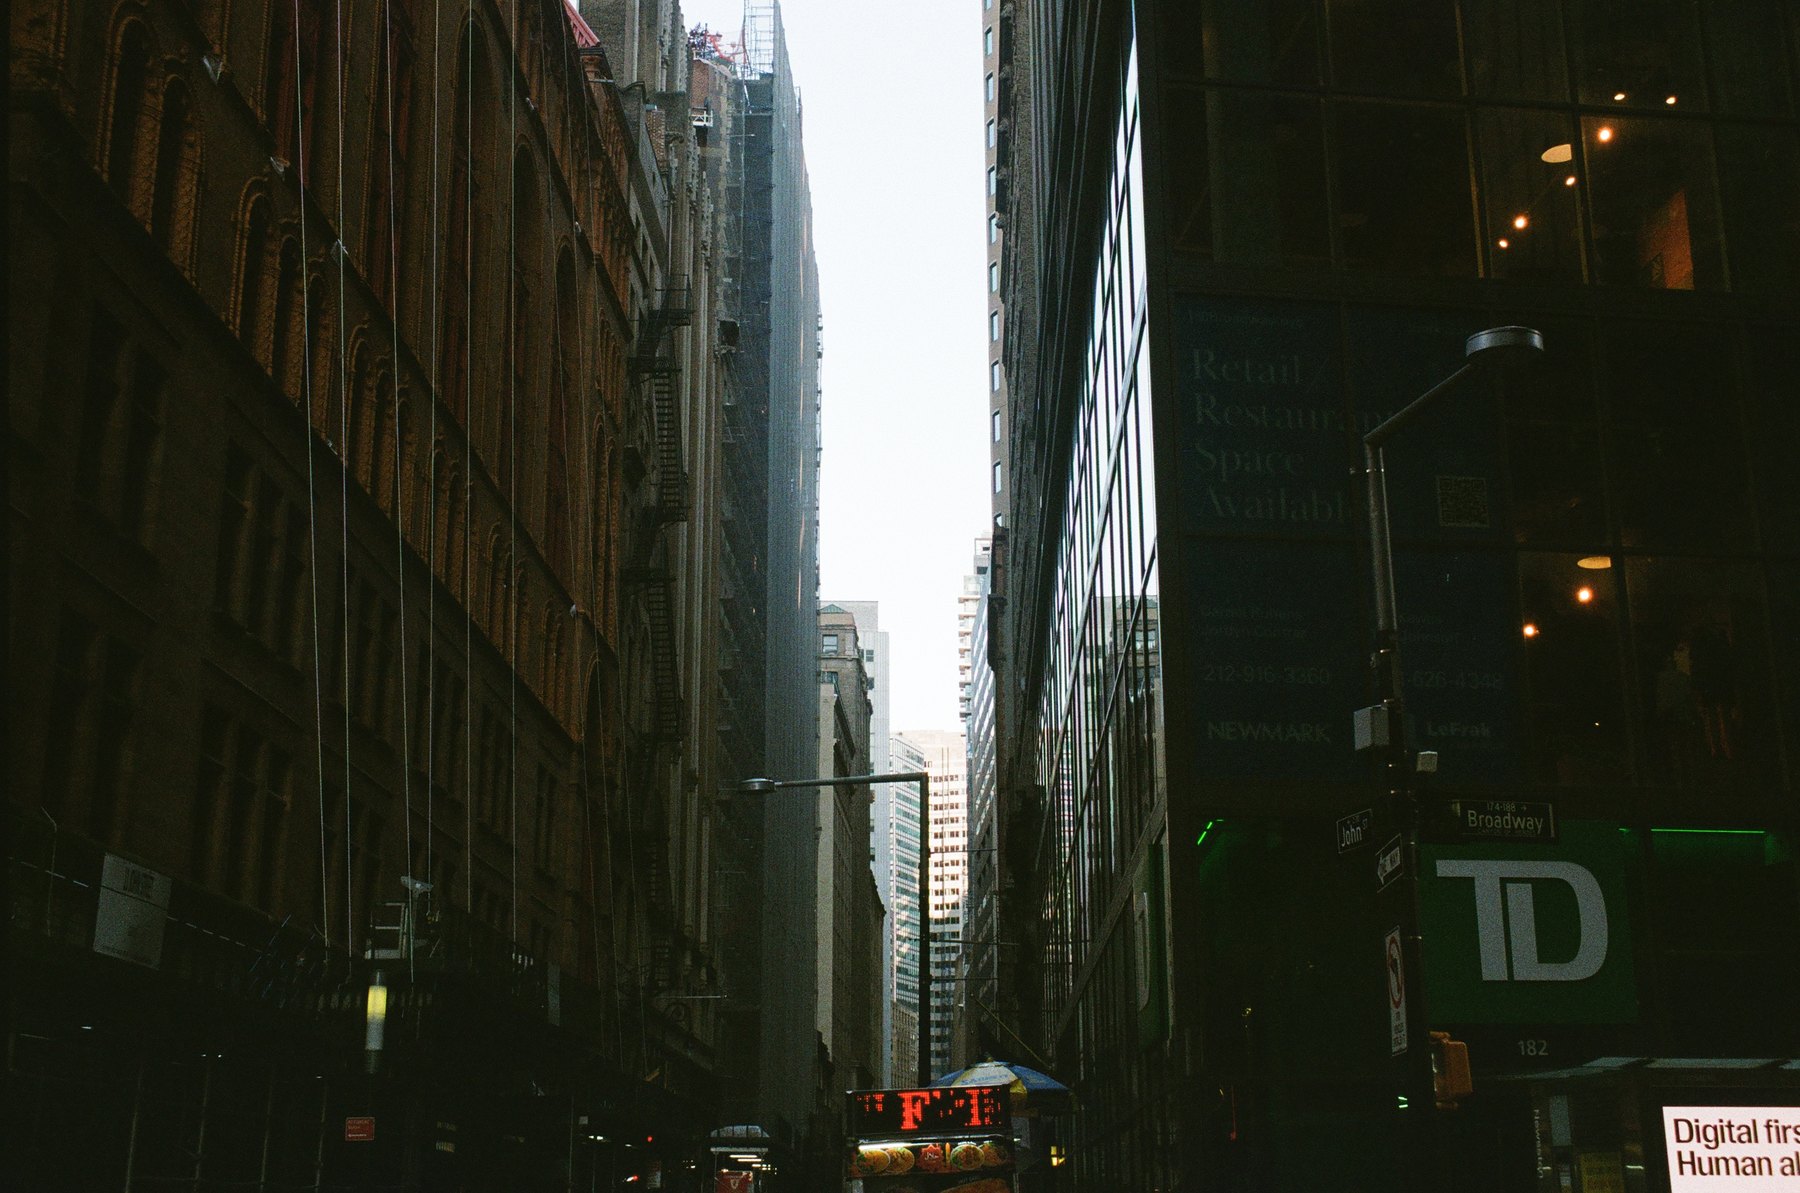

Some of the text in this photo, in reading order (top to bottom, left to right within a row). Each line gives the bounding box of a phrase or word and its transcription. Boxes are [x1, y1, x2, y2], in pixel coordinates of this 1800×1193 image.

[1193, 349, 1302, 384] Retail
[1194, 439, 1303, 482] Space
[1198, 484, 1351, 523] Availabl
[1208, 721, 1331, 743] NEWMARK
[1341, 825, 1362, 847] John
[1467, 810, 1543, 835] Broadway
[1436, 860, 1609, 981] TD
[1518, 1039, 1549, 1056] 182
[1673, 1118, 1759, 1150] Digital
[1677, 1150, 1773, 1176] Human
